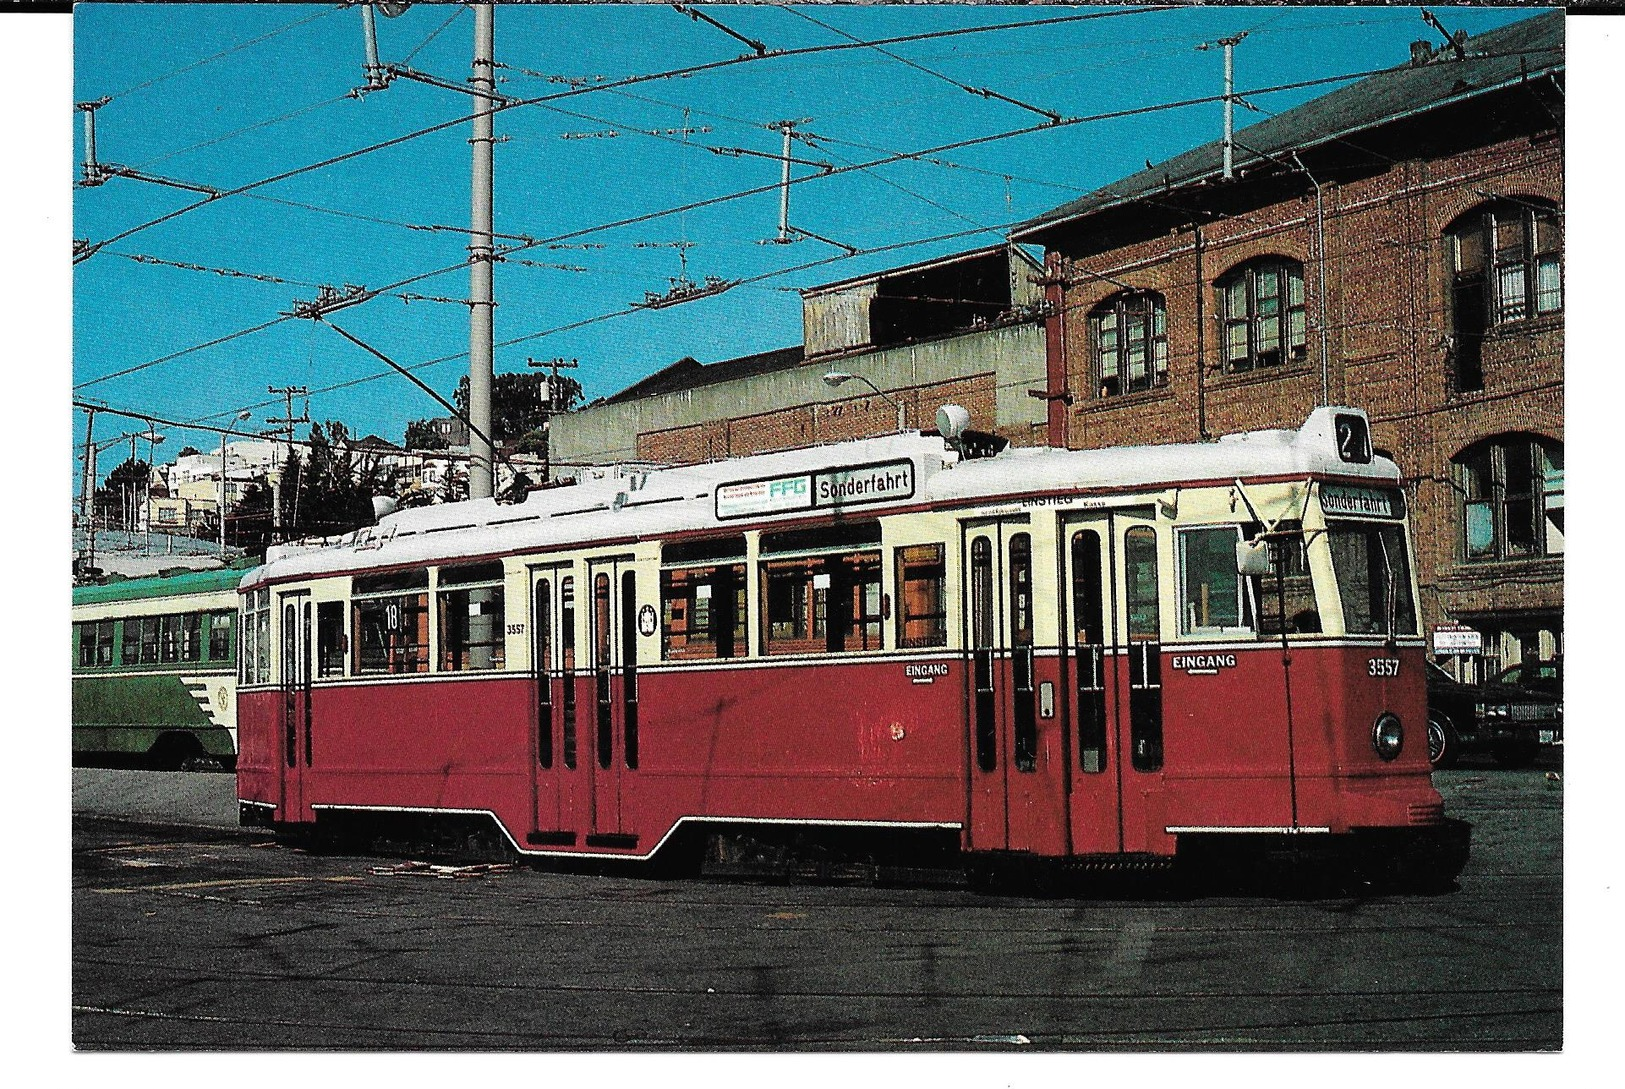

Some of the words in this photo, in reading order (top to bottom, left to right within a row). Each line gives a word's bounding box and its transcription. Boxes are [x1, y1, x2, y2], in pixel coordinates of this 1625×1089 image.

[770, 478, 806, 498] FFG
[820, 470, 908, 499] Sonderfahrt
[385, 604, 398, 629] 18
[507, 624, 525, 635] 3557
[905, 663, 948, 676] EINGANG
[1172, 654, 1237, 668] EINGANG
[1368, 659, 1400, 676] 3557
